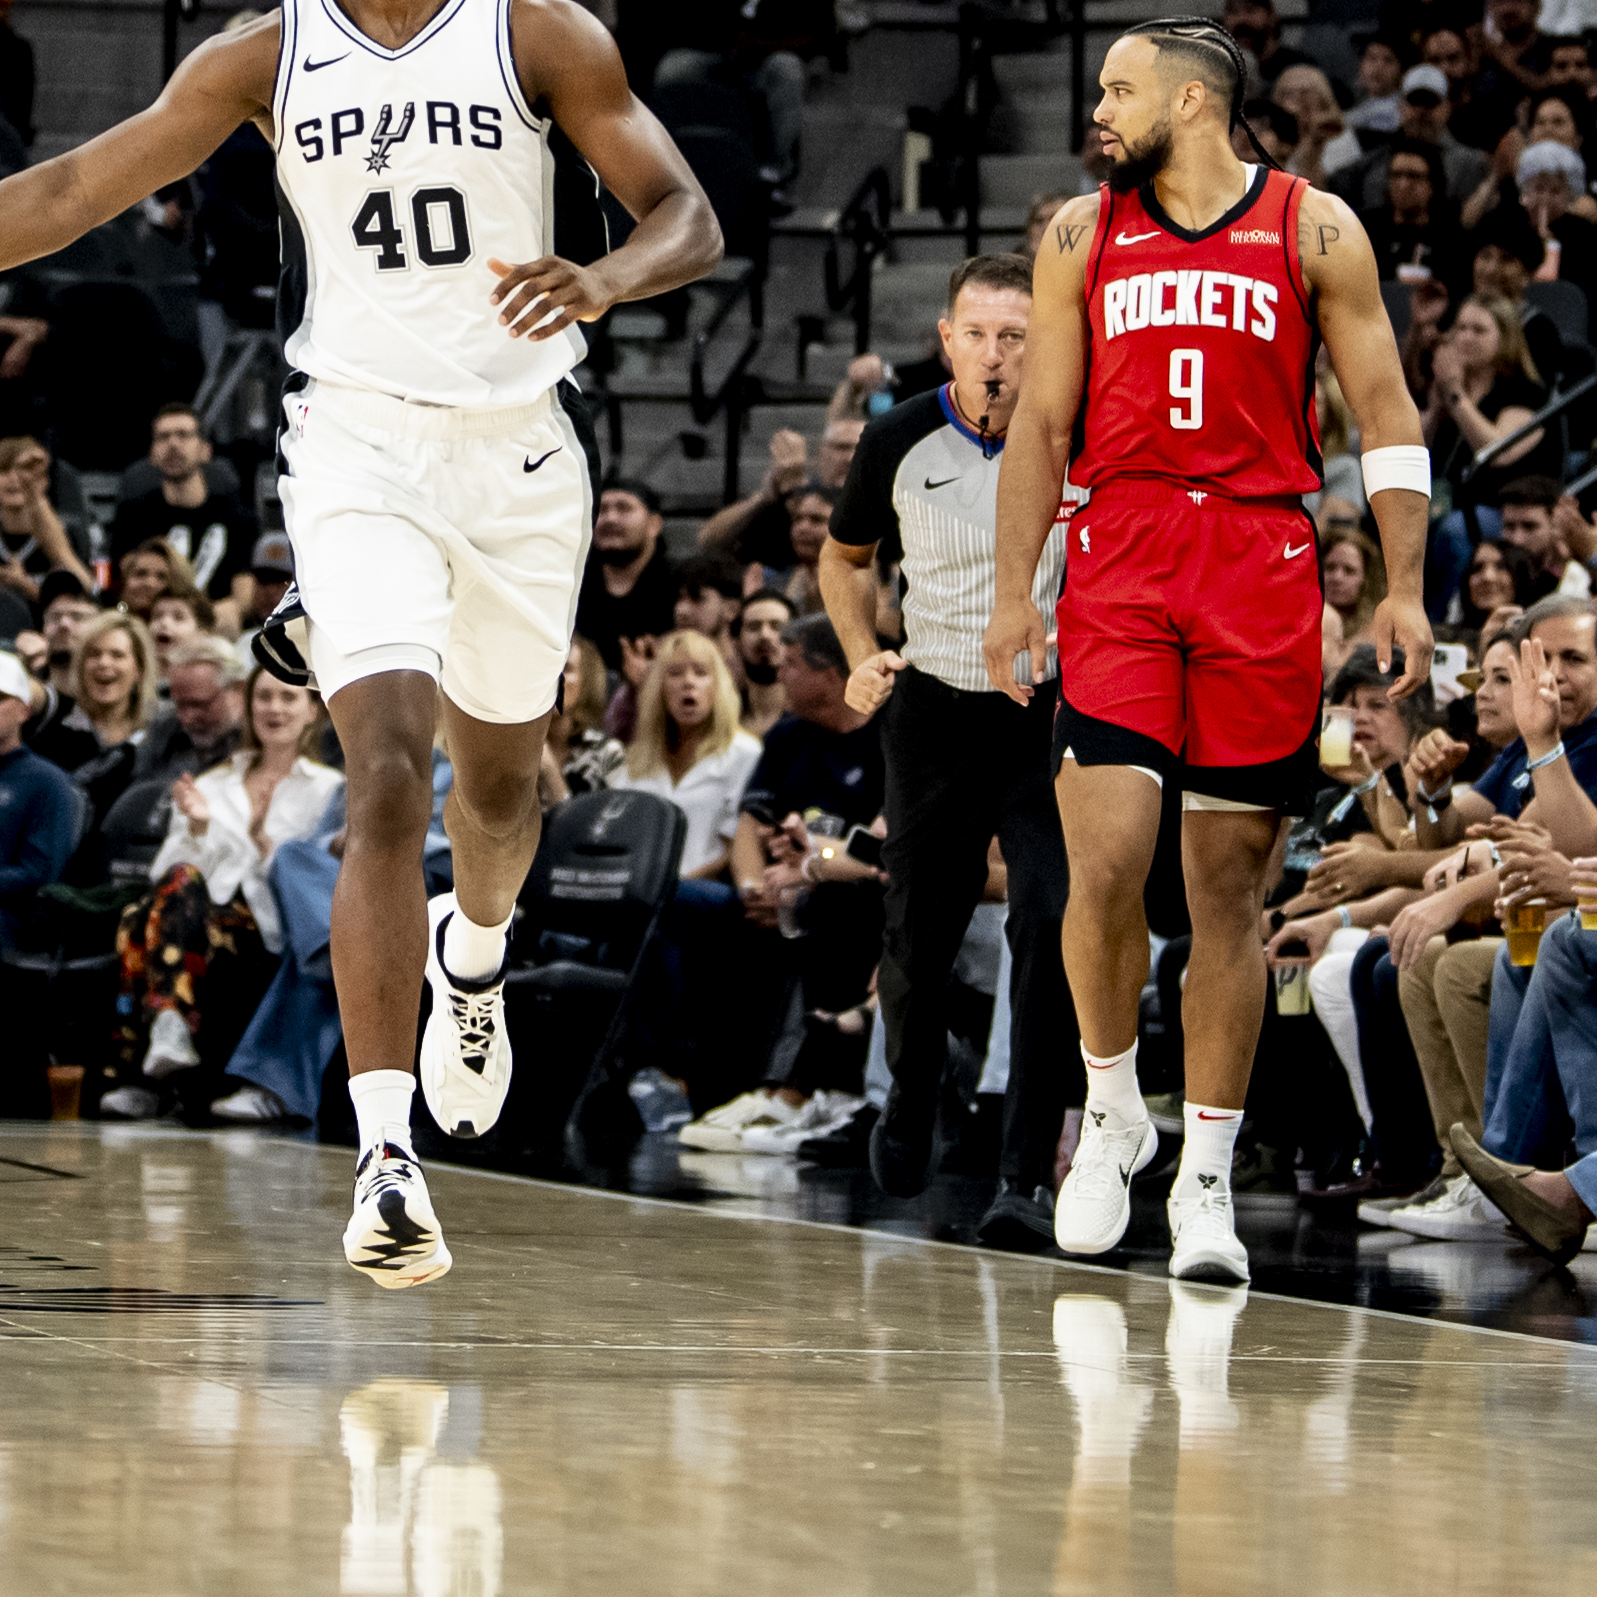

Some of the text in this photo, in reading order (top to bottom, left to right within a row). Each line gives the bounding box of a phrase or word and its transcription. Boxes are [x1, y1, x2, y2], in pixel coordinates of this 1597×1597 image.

[295, 101, 502, 175] SPURS
[348, 182, 476, 274] 40
[1104, 270, 1278, 342] ROCKETS
[1169, 348, 1203, 430] 9
